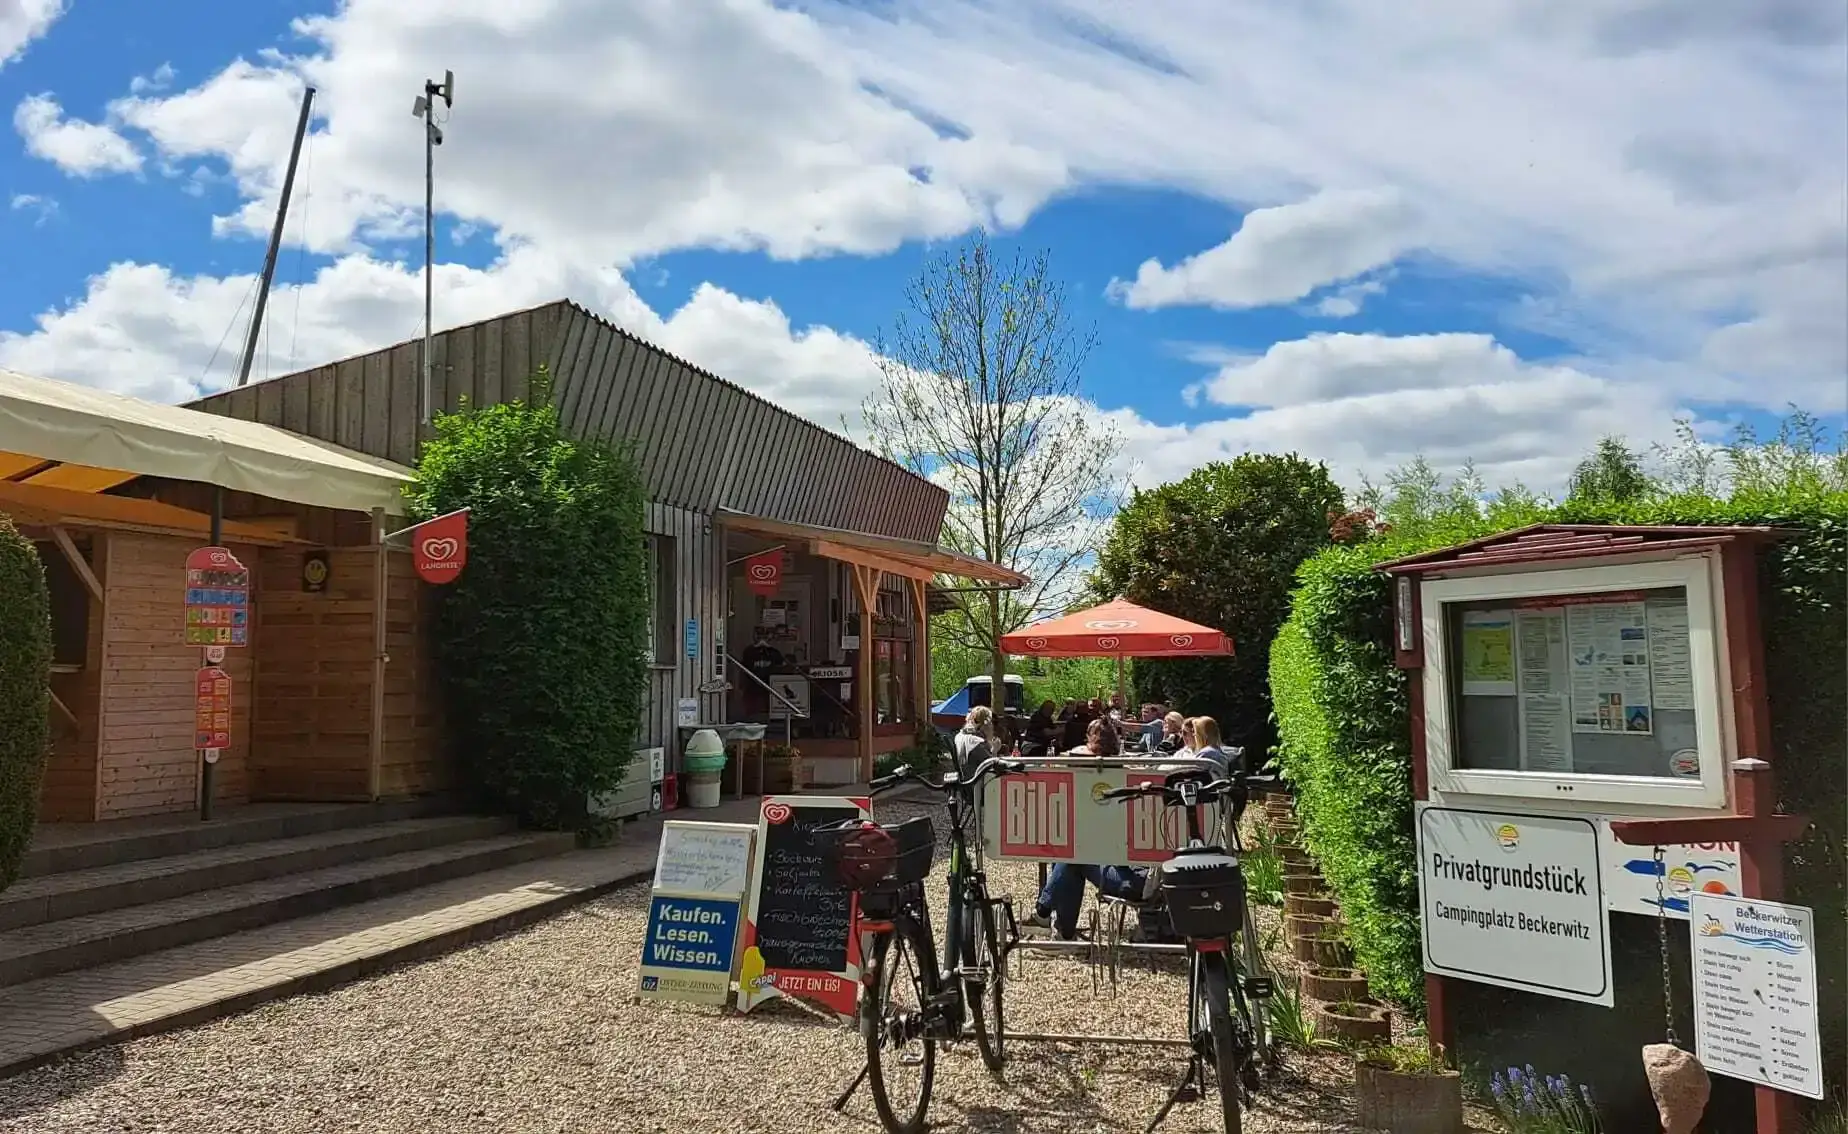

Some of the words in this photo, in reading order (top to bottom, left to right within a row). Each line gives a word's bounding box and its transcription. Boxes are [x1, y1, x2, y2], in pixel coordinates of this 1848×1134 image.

[1007, 781, 1068, 846] Bild
[1433, 852, 1588, 896] Privatgrundstück
[659, 904, 726, 925] Kaufen.
[1435, 900, 1515, 930] Campingplatz
[1518, 912, 1591, 940] Beckerwitz
[1736, 907, 1803, 926] Beckerwitzer
[656, 924, 714, 944] Lesen.
[1734, 922, 1803, 943] Wetterstation
[653, 943, 722, 965] Wissen.
[778, 976, 805, 990] JETZT
[807, 977, 822, 991] EIN
[824, 978, 841, 993] EIS!
